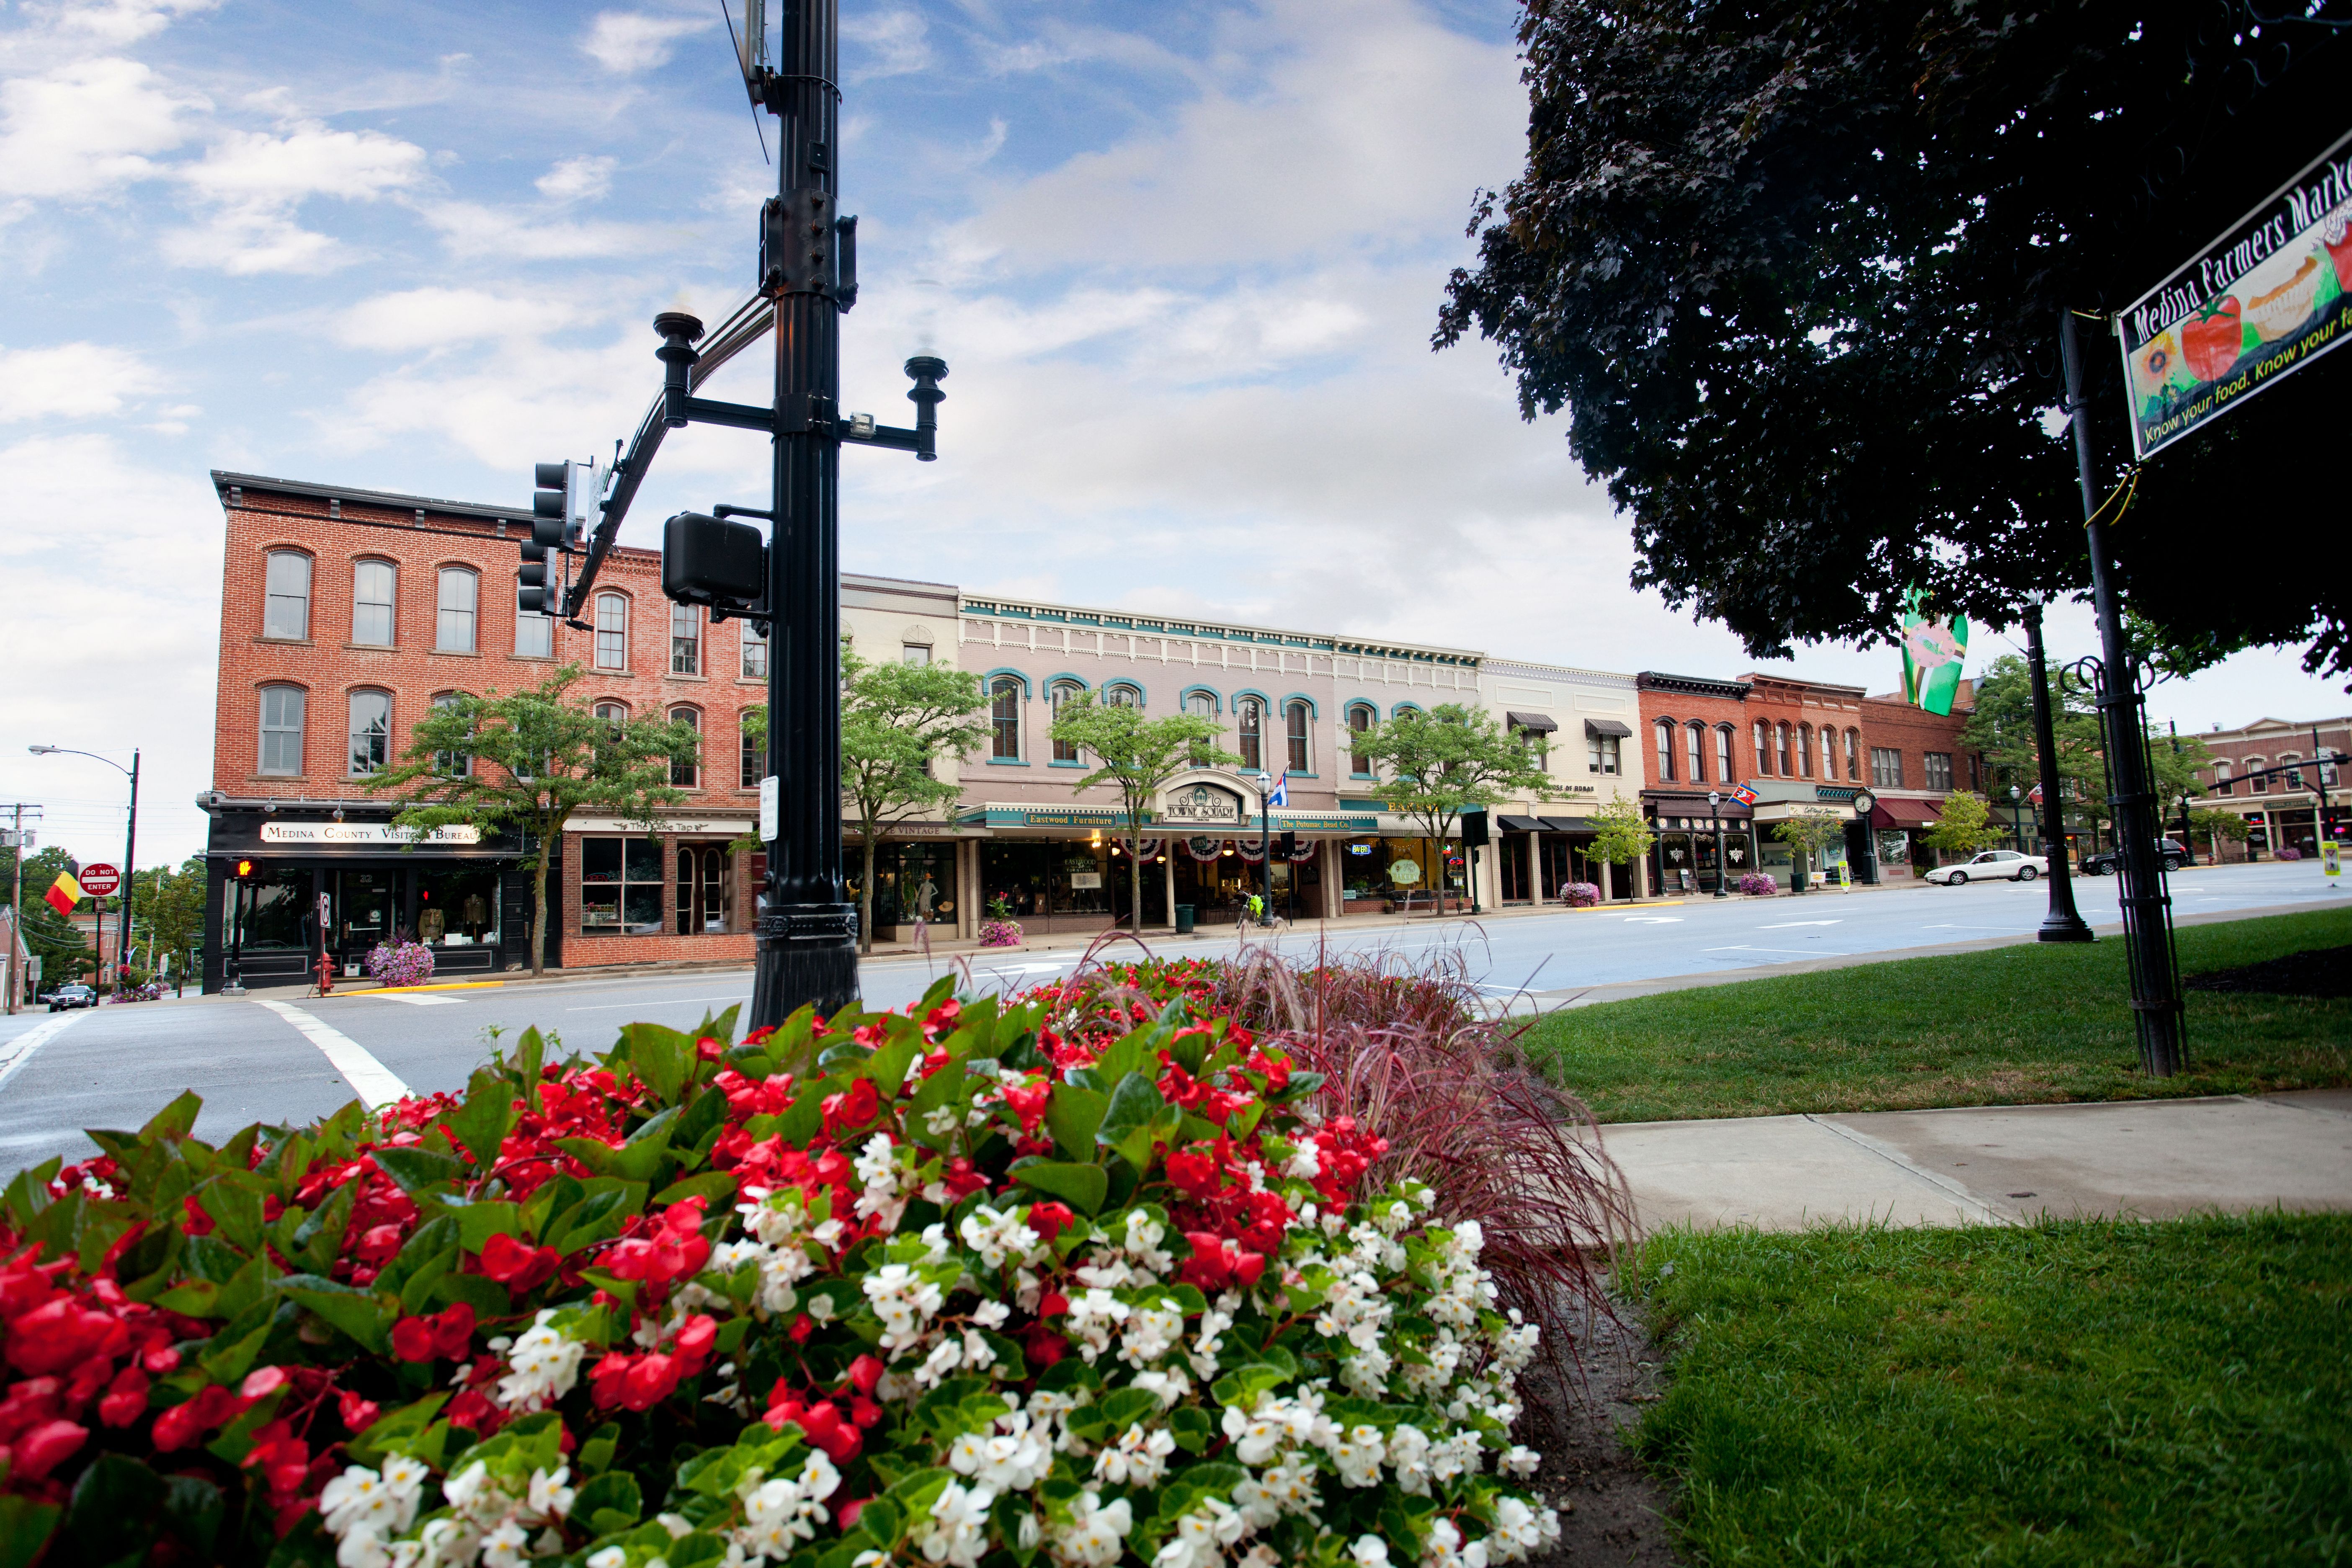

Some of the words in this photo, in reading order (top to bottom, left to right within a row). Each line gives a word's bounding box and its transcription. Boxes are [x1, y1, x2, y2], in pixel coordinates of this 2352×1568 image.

[2134, 281, 2201, 346] Medina
[2199, 213, 2285, 295] Farmers
[2145, 417, 2178, 444] Know
[2182, 396, 2212, 426] your
[2215, 371, 2251, 404] food.
[2255, 345, 2297, 380] Know
[2301, 320, 2337, 357] your
[1168, 806, 1198, 816] TOWNE
[1201, 807, 1234, 818] SQUARE
[1030, 815, 1068, 824] Eastwood
[1073, 816, 1112, 825] Furniture
[267, 827, 315, 838] MEDINA
[325, 828, 372, 838] COUNTY
[630, 822, 648, 830] The
[676, 823, 693, 832] Tap
